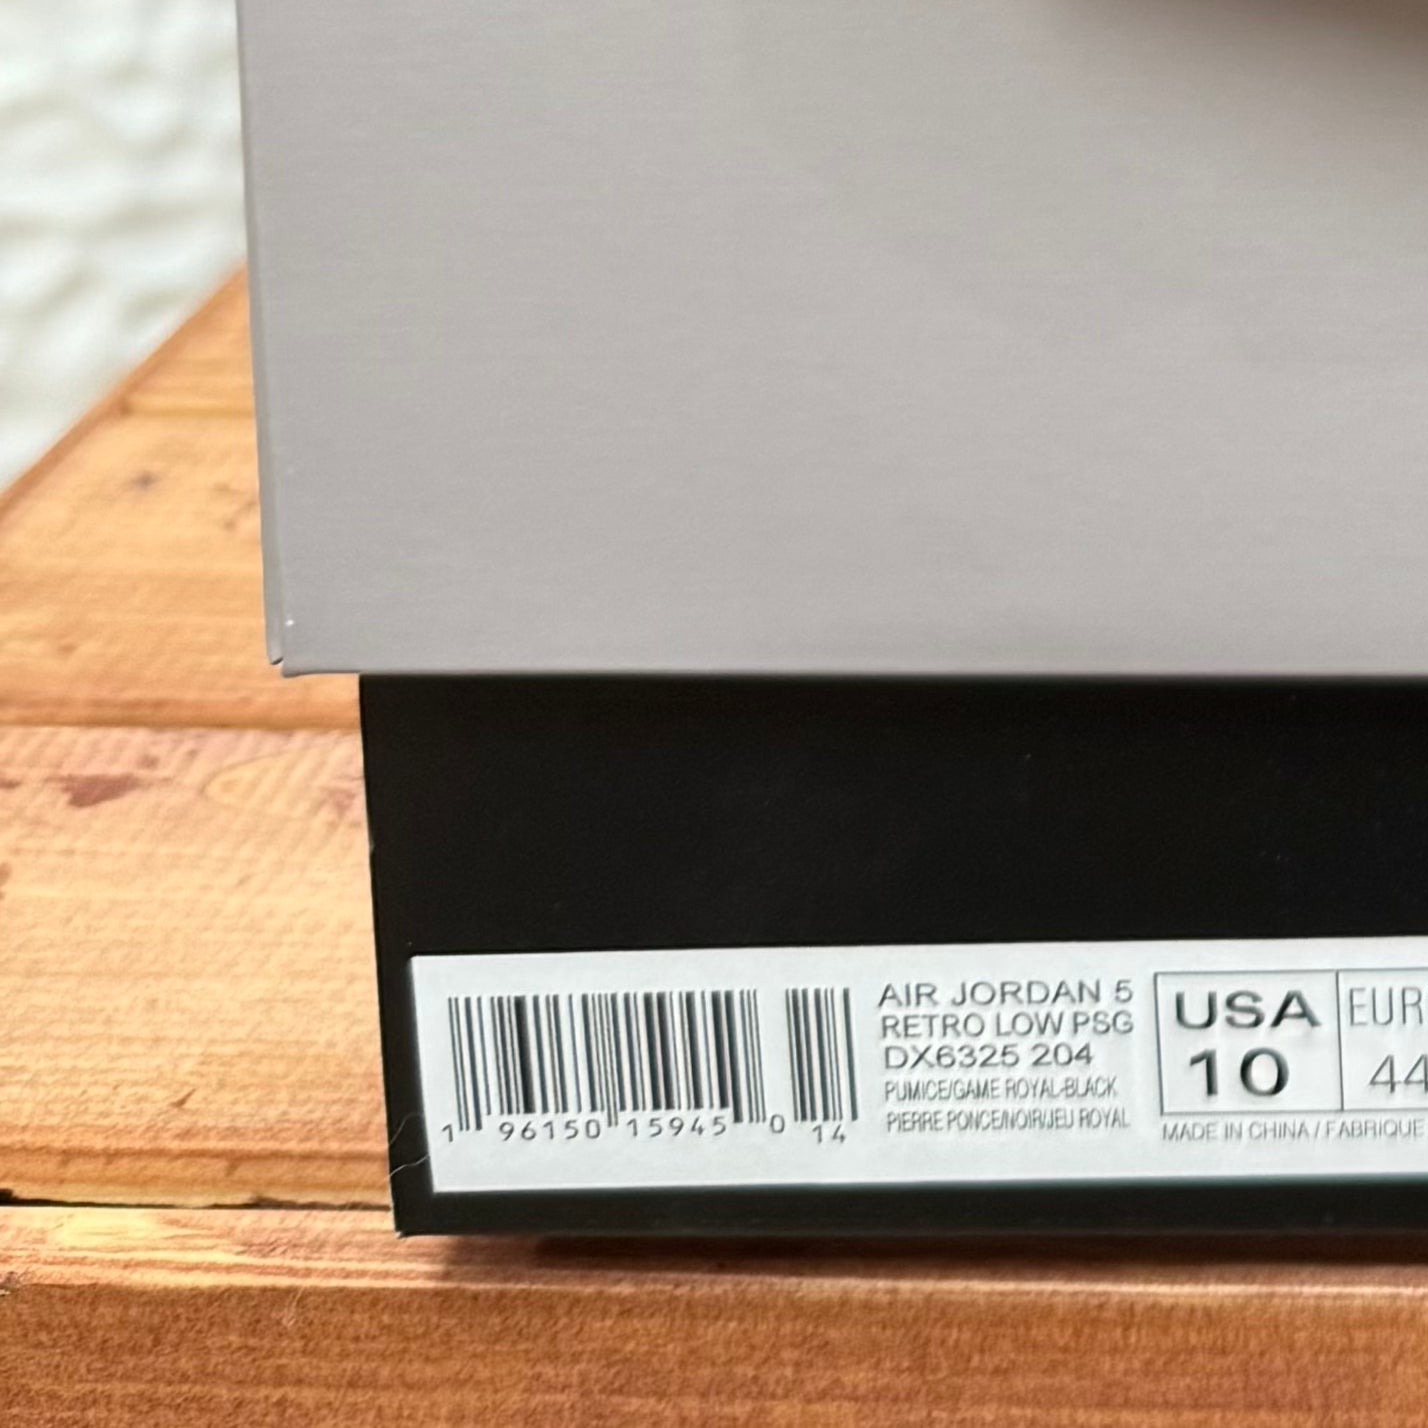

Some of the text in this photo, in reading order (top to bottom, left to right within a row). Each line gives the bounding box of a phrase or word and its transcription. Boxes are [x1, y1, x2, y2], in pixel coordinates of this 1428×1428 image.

[879, 979, 1134, 1007] AIR JORDAN 5
[1174, 989, 1322, 1030] USA
[881, 1010, 1134, 1039] RETRO LOW PSG
[884, 1042, 1094, 1069] DX6325 204
[1189, 1046, 1290, 1097] 10
[885, 1076, 1118, 1101] PUMICE/GAME ROYAL-BLACK
[441, 1114, 846, 1144] 1 96150 15945 0 14
[887, 1110, 944, 1132] PIERRE
[1079, 1107, 1131, 1128] ROYAL
[1162, 1121, 1219, 1142] MADE
[1224, 1121, 1243, 1141] IN
[1249, 1119, 1310, 1141] CHINA
[1325, 1117, 1425, 1140] FABRIQUE
